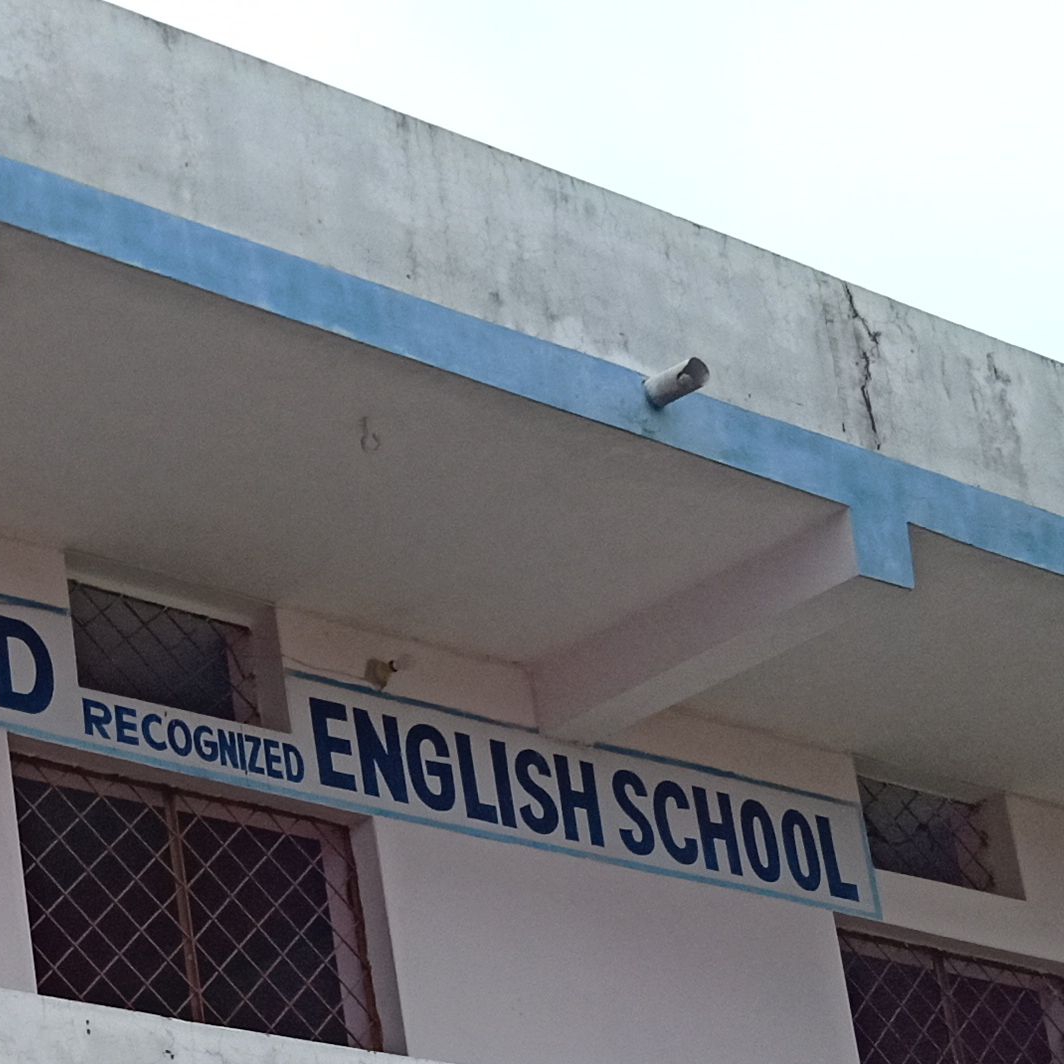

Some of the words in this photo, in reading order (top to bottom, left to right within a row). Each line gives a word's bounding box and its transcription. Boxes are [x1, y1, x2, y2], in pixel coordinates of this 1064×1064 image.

[82, 698, 304, 783] RECOGNIZED
[309, 697, 605, 847] ENGLISH
[612, 769, 860, 903] SCHOOL
